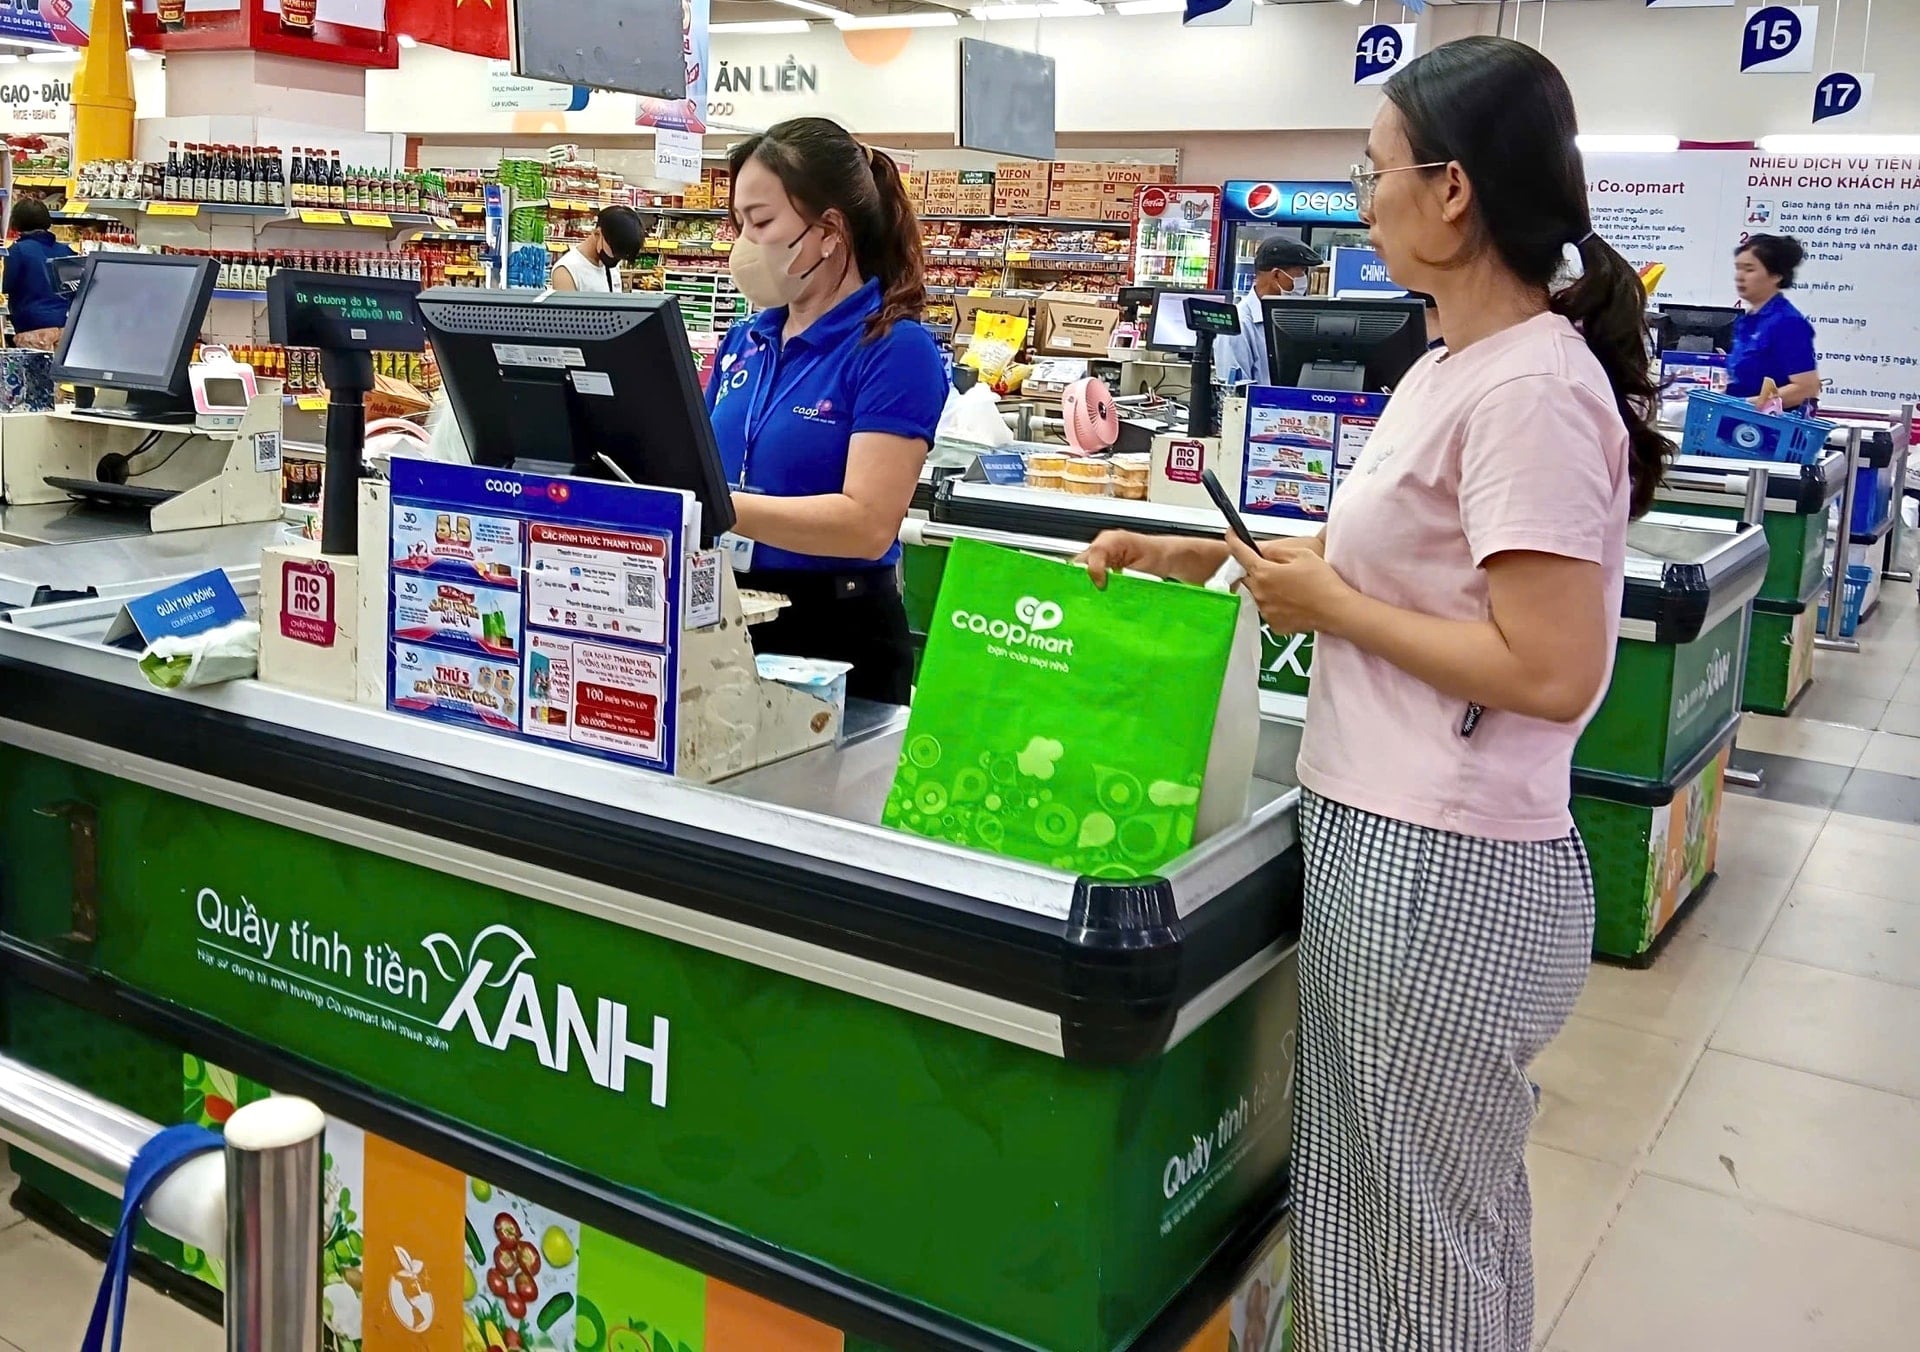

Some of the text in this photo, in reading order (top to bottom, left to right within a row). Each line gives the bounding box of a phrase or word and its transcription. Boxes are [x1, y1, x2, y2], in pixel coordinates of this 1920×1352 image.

[1750, 20, 1792, 50] 15
[1361, 36, 1396, 64] 16
[714, 54, 817, 92] ĂN LIỀN
[0, 78, 71, 107] GẠO ĐẬU
[1820, 83, 1855, 107] 17
[707, 102, 734, 116] OOD
[1803, 158, 1842, 172] DỊCH
[1848, 158, 1869, 172] VỤ
[998, 168, 1031, 178] VIFON
[1107, 172, 1142, 182] VIFON
[1598, 179, 1685, 196] Co.opmart
[1748, 173, 1920, 190] DÀNH CHO KHÁCH HÀ
[997, 188, 1030, 198] VIFON
[1292, 190, 1358, 216] peps
[1746, 196, 1751, 208] 1
[1782, 201, 1803, 209] Giao
[1806, 201, 1831, 211] hàng
[1104, 210, 1130, 220] VIFO
[1826, 214, 1832, 222] 6
[1836, 214, 1850, 222] km
[1779, 226, 1815, 234] 200.000
[1739, 232, 1750, 245] 2
[312, 295, 378, 308] chuong do kg
[386, 310, 404, 321] VND
[1819, 316, 1840, 325] mua
[1826, 352, 1891, 364] trong vòng 15
[1311, 394, 1337, 404] co.op
[1870, 390, 1896, 400] trong
[1176, 448, 1195, 458] mo
[1176, 458, 1194, 467] mo
[485, 478, 522, 498] co.op
[403, 512, 417, 524] 30
[435, 514, 472, 548] 5.5
[602, 538, 630, 549] THANH
[294, 576, 320, 594] mo
[404, 582, 418, 594] 30
[156, 595, 180, 616] QUẦY
[178, 593, 196, 610] TẠM
[294, 594, 320, 612] mo
[288, 628, 308, 640] THANH
[951, 609, 1074, 656] co.opmart
[405, 651, 418, 664] 30
[436, 666, 470, 685] THỨ 3
[586, 687, 604, 702] 100
[196, 886, 428, 1004] Quầy tính tiền
[381, 1014, 397, 1034] khi
[438, 958, 669, 1108] XANH
[1162, 1132, 1214, 1200] Quầy
